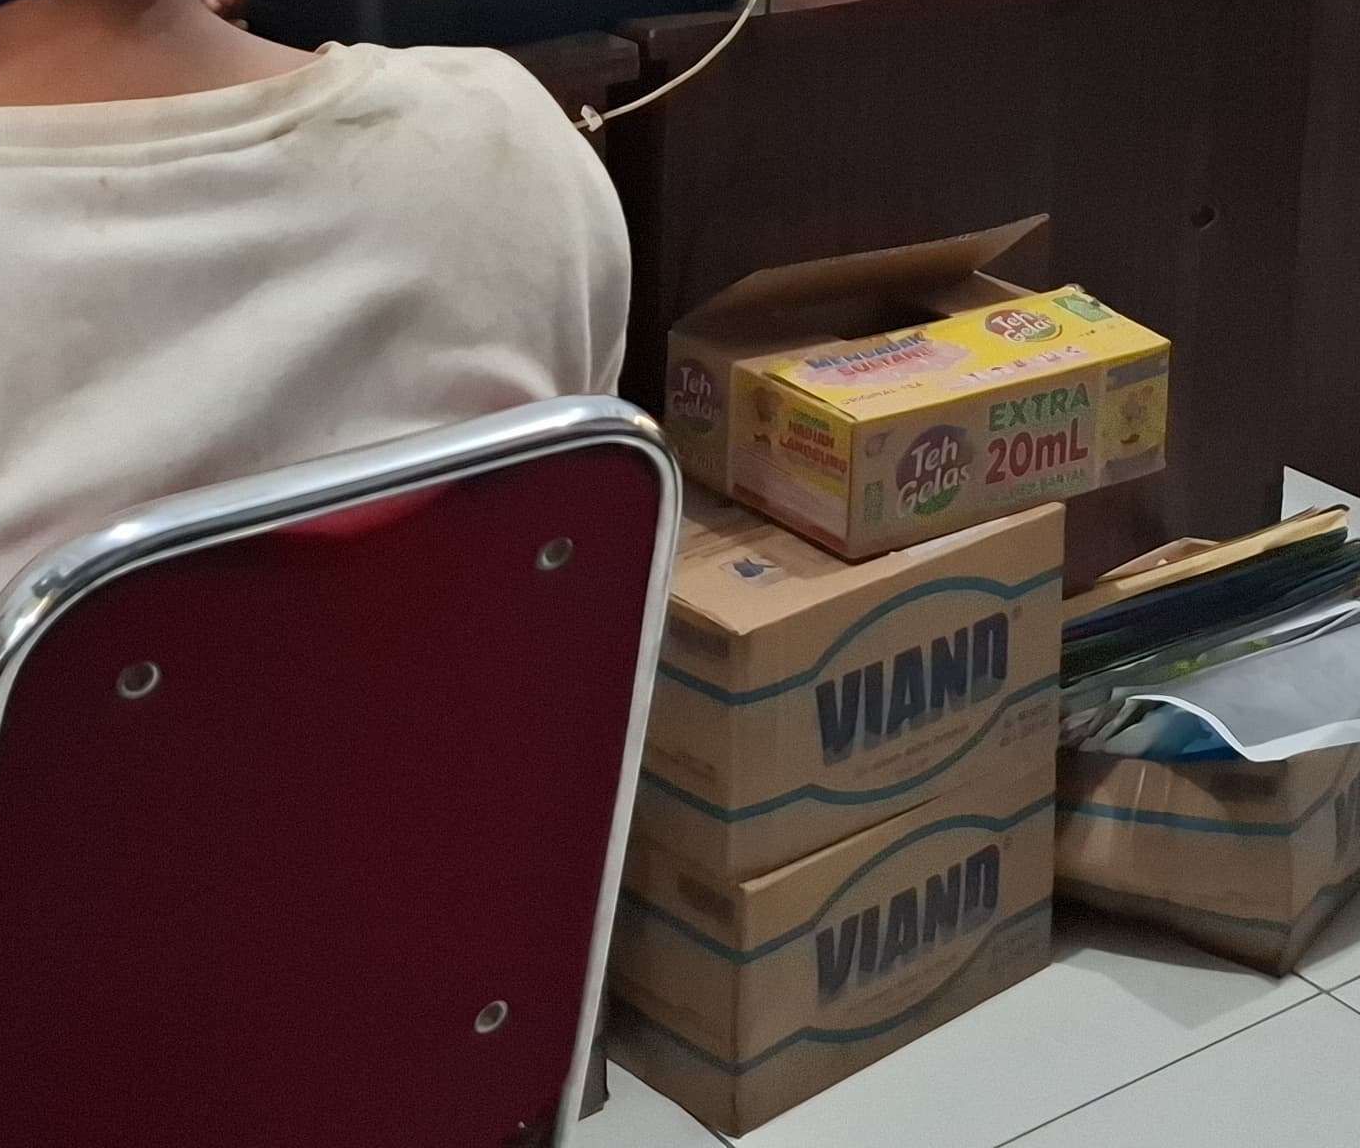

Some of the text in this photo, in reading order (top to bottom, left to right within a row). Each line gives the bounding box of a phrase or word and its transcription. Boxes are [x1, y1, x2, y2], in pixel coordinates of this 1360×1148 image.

[991, 312, 1036, 330] Teh
[990, 383, 1090, 432] EXTRA
[911, 435, 958, 479] Teh
[897, 464, 971, 518] Gelas
[815, 612, 1009, 765] VIAND
[815, 843, 1001, 999] VIAND
